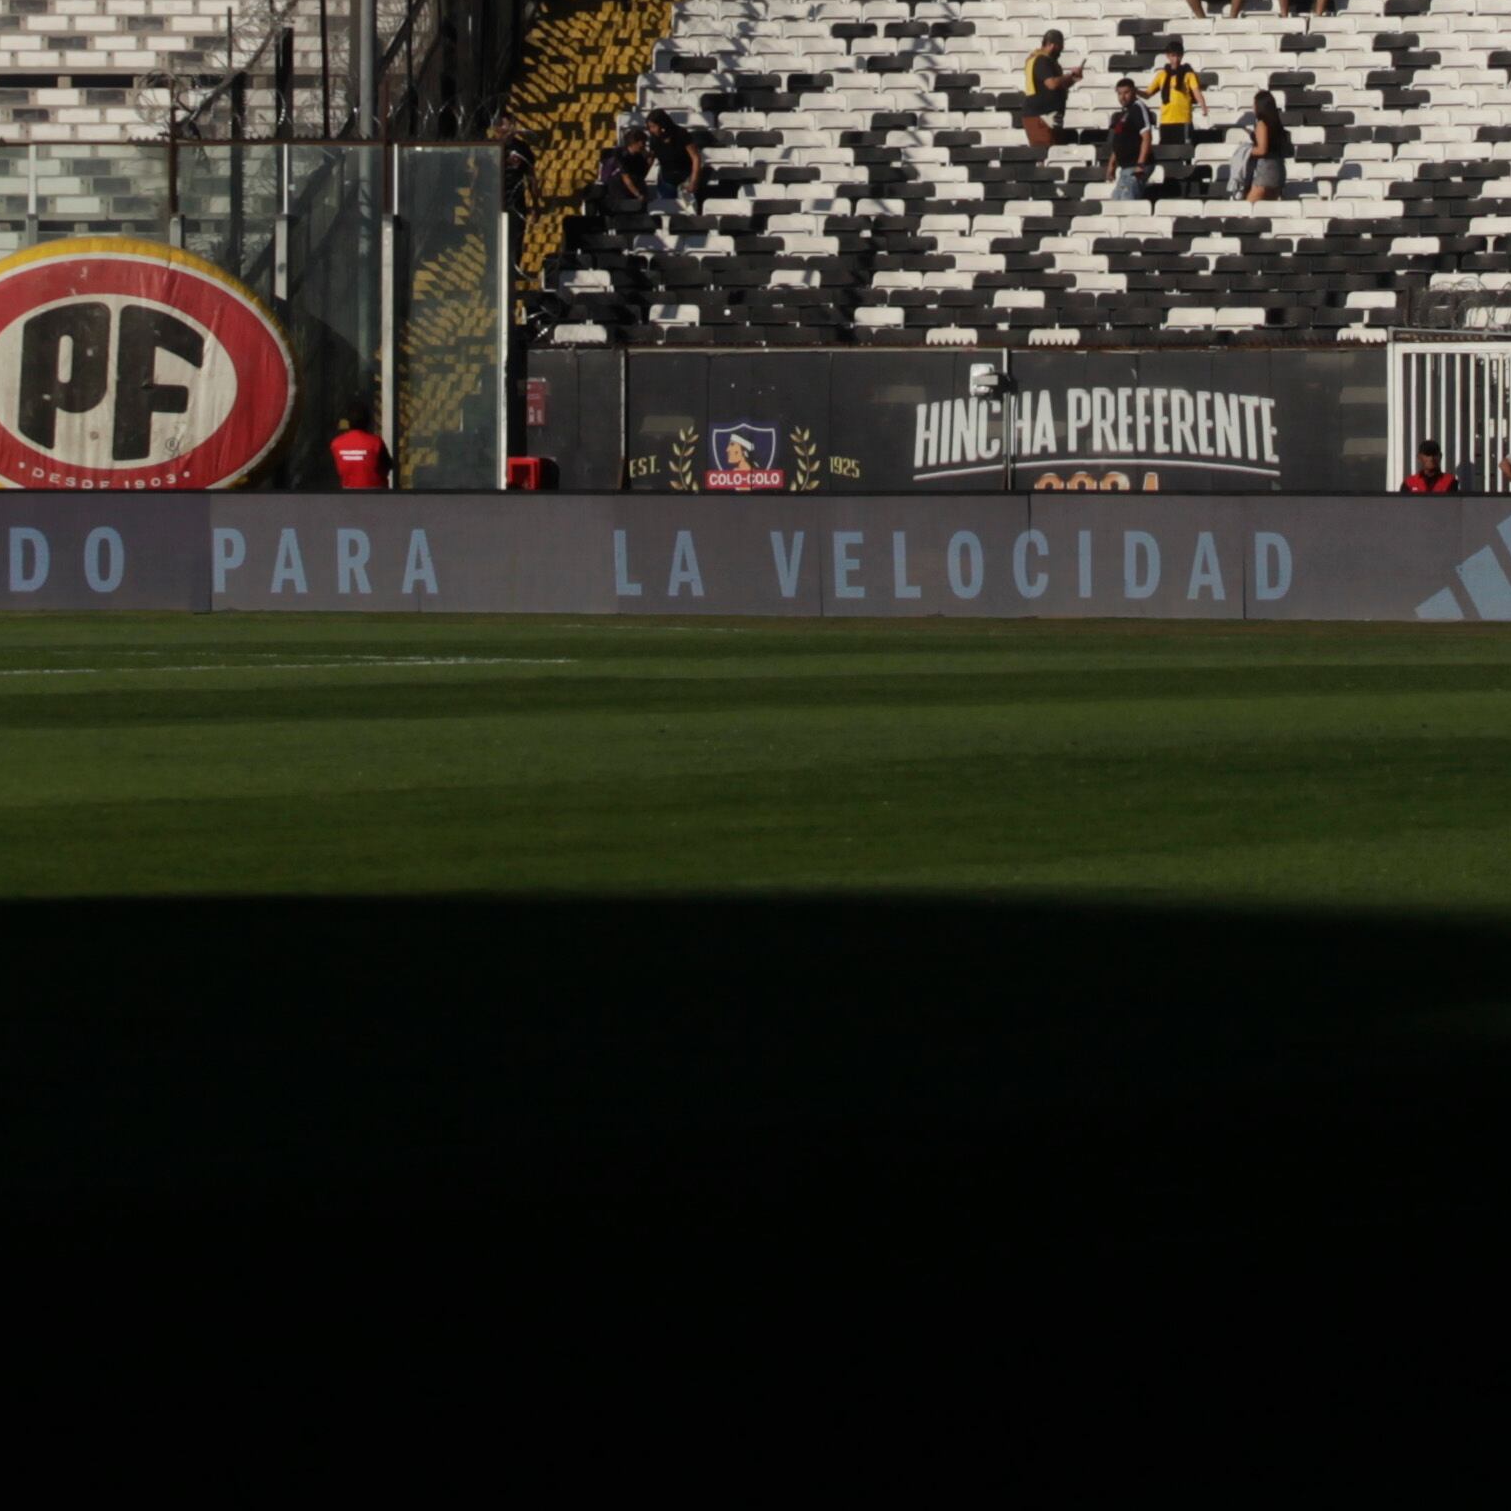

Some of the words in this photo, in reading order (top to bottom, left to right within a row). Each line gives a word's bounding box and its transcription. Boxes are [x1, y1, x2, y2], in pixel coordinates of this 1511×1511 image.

[18, 301, 205, 461] PF
[913, 389, 1057, 468] HINCHA
[1066, 386, 1280, 464] PREFERENTE
[628, 455, 661, 478] EST.
[829, 456, 861, 478] 1925
[708, 472, 780, 486] COLO-COLO
[211, 527, 440, 595] PARA
[613, 529, 704, 597] LA
[770, 530, 1292, 600] VELOCIDAD
